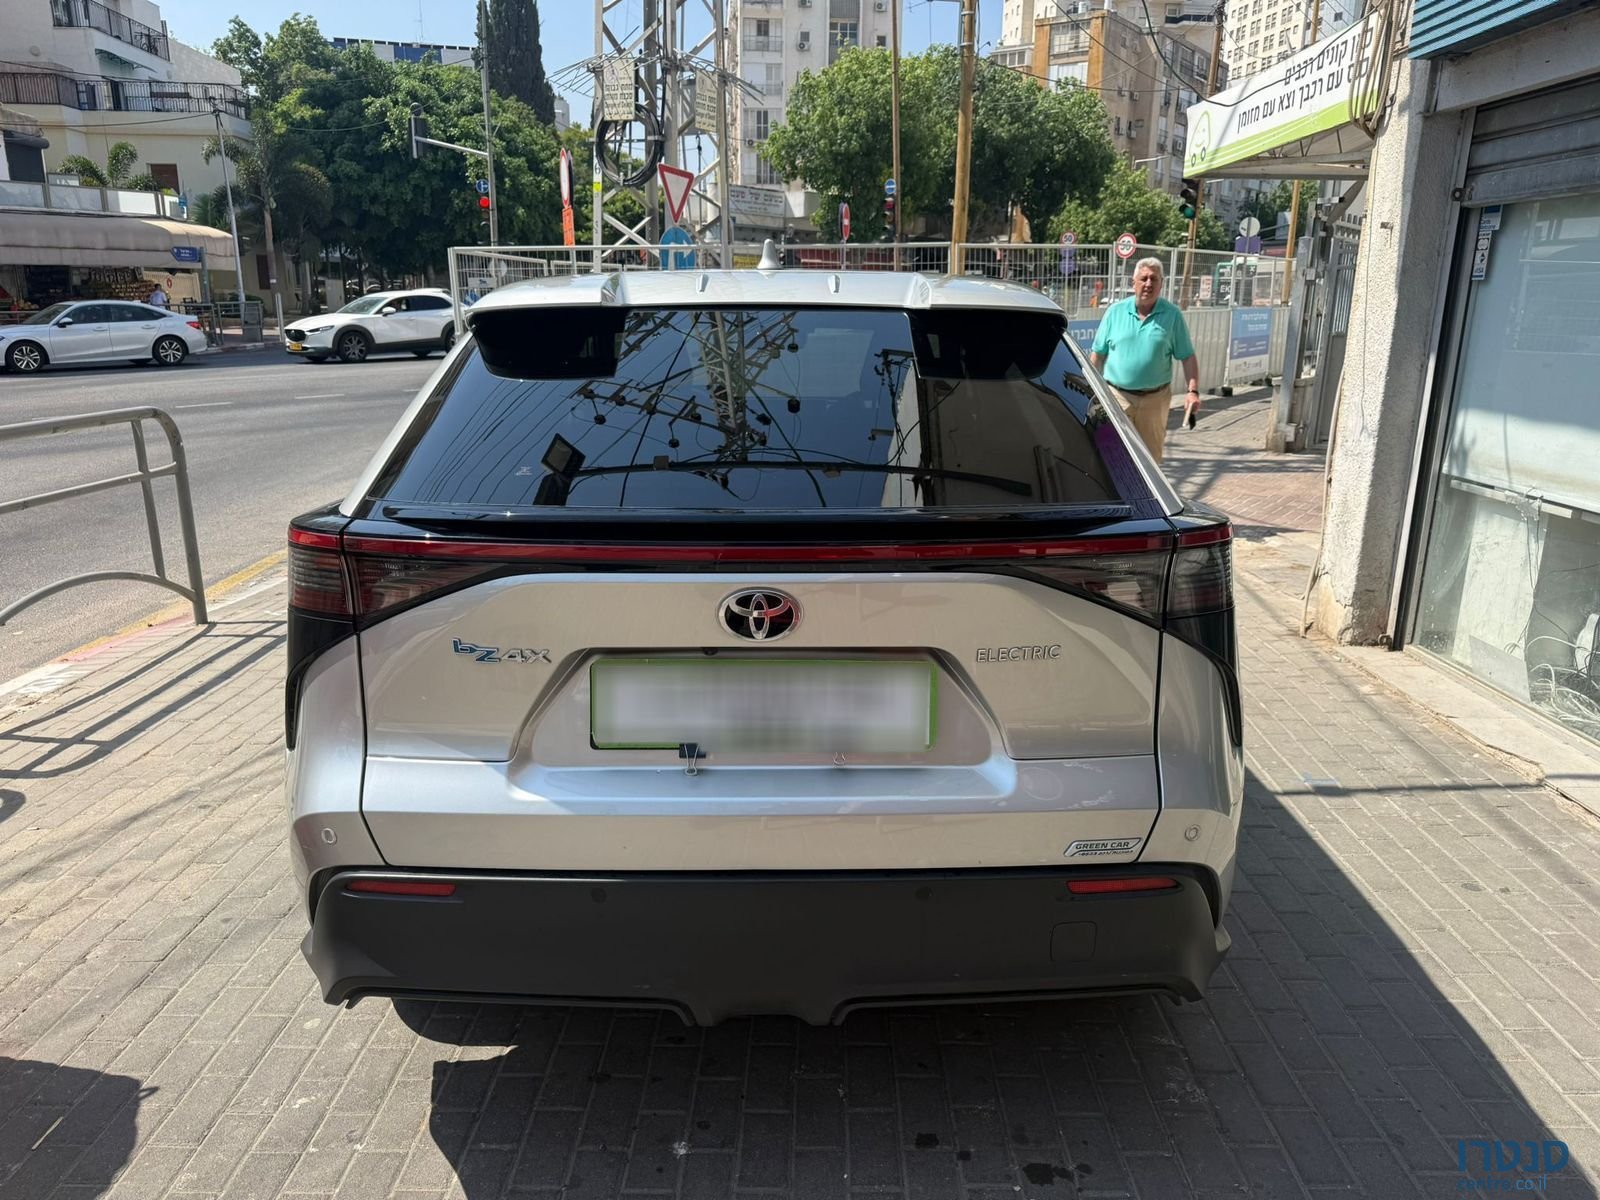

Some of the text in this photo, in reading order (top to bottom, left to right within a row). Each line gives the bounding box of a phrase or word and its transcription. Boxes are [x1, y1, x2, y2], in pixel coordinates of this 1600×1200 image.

[1317, 39, 1349, 71] קונים
[1284, 57, 1314, 86] רכבים
[1326, 68, 1344, 92] עם
[1278, 89, 1296, 113] וצא
[1298, 77, 1323, 110] רכבך
[1237, 105, 1260, 134] מזומן
[1262, 98, 1277, 119] עם
[1064, 234, 1073, 242] 50
[976, 644, 1062, 663] ELECTRIC
[1075, 842, 1108, 850] GREEN
